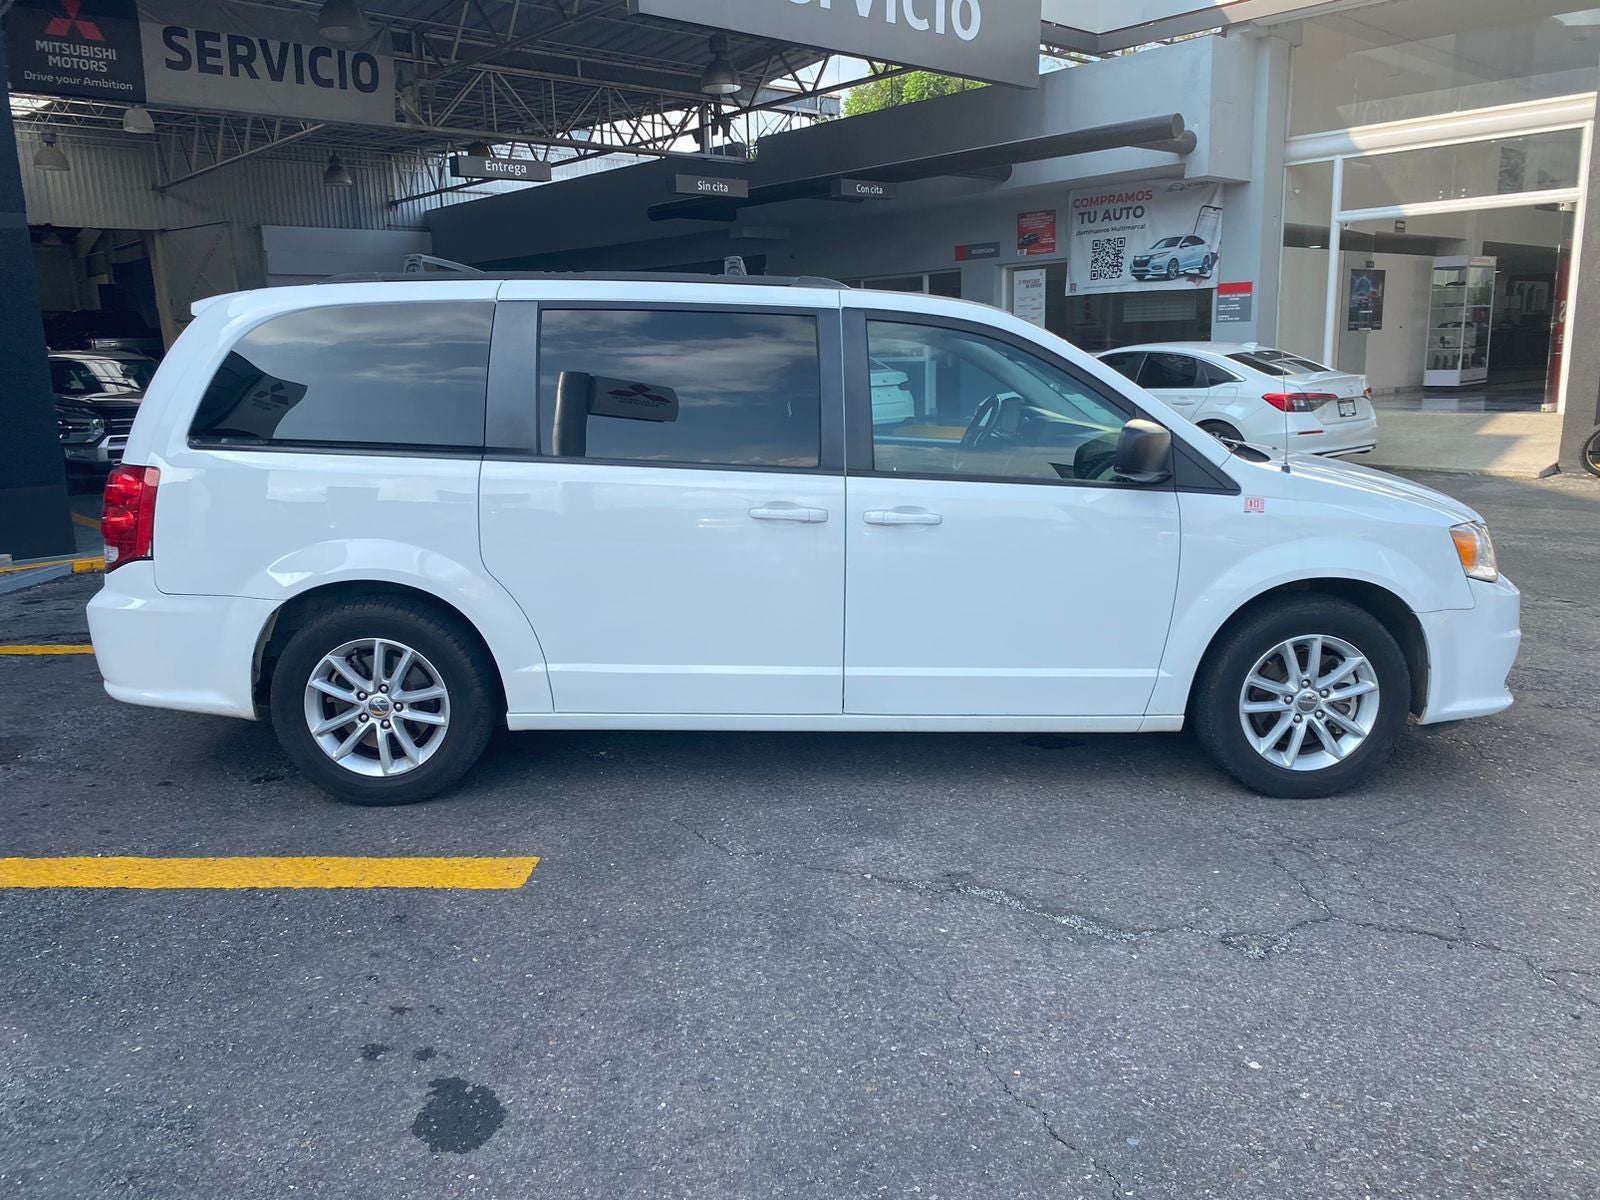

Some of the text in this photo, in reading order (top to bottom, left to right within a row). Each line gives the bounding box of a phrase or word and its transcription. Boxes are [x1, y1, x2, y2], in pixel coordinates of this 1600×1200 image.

[35, 40, 117, 60] MITSUBISHI
[161, 26, 380, 93] SERVICIO
[47, 55, 108, 73] MOTORS
[24, 70, 133, 90] Drive your Ambition
[485, 160, 527, 176] Entrega
[697, 180, 729, 193] Sin cita
[856, 183, 883, 194] Con cita
[1073, 190, 1153, 209] COMPRAMOS
[1078, 205, 1146, 225] TU AUTO
